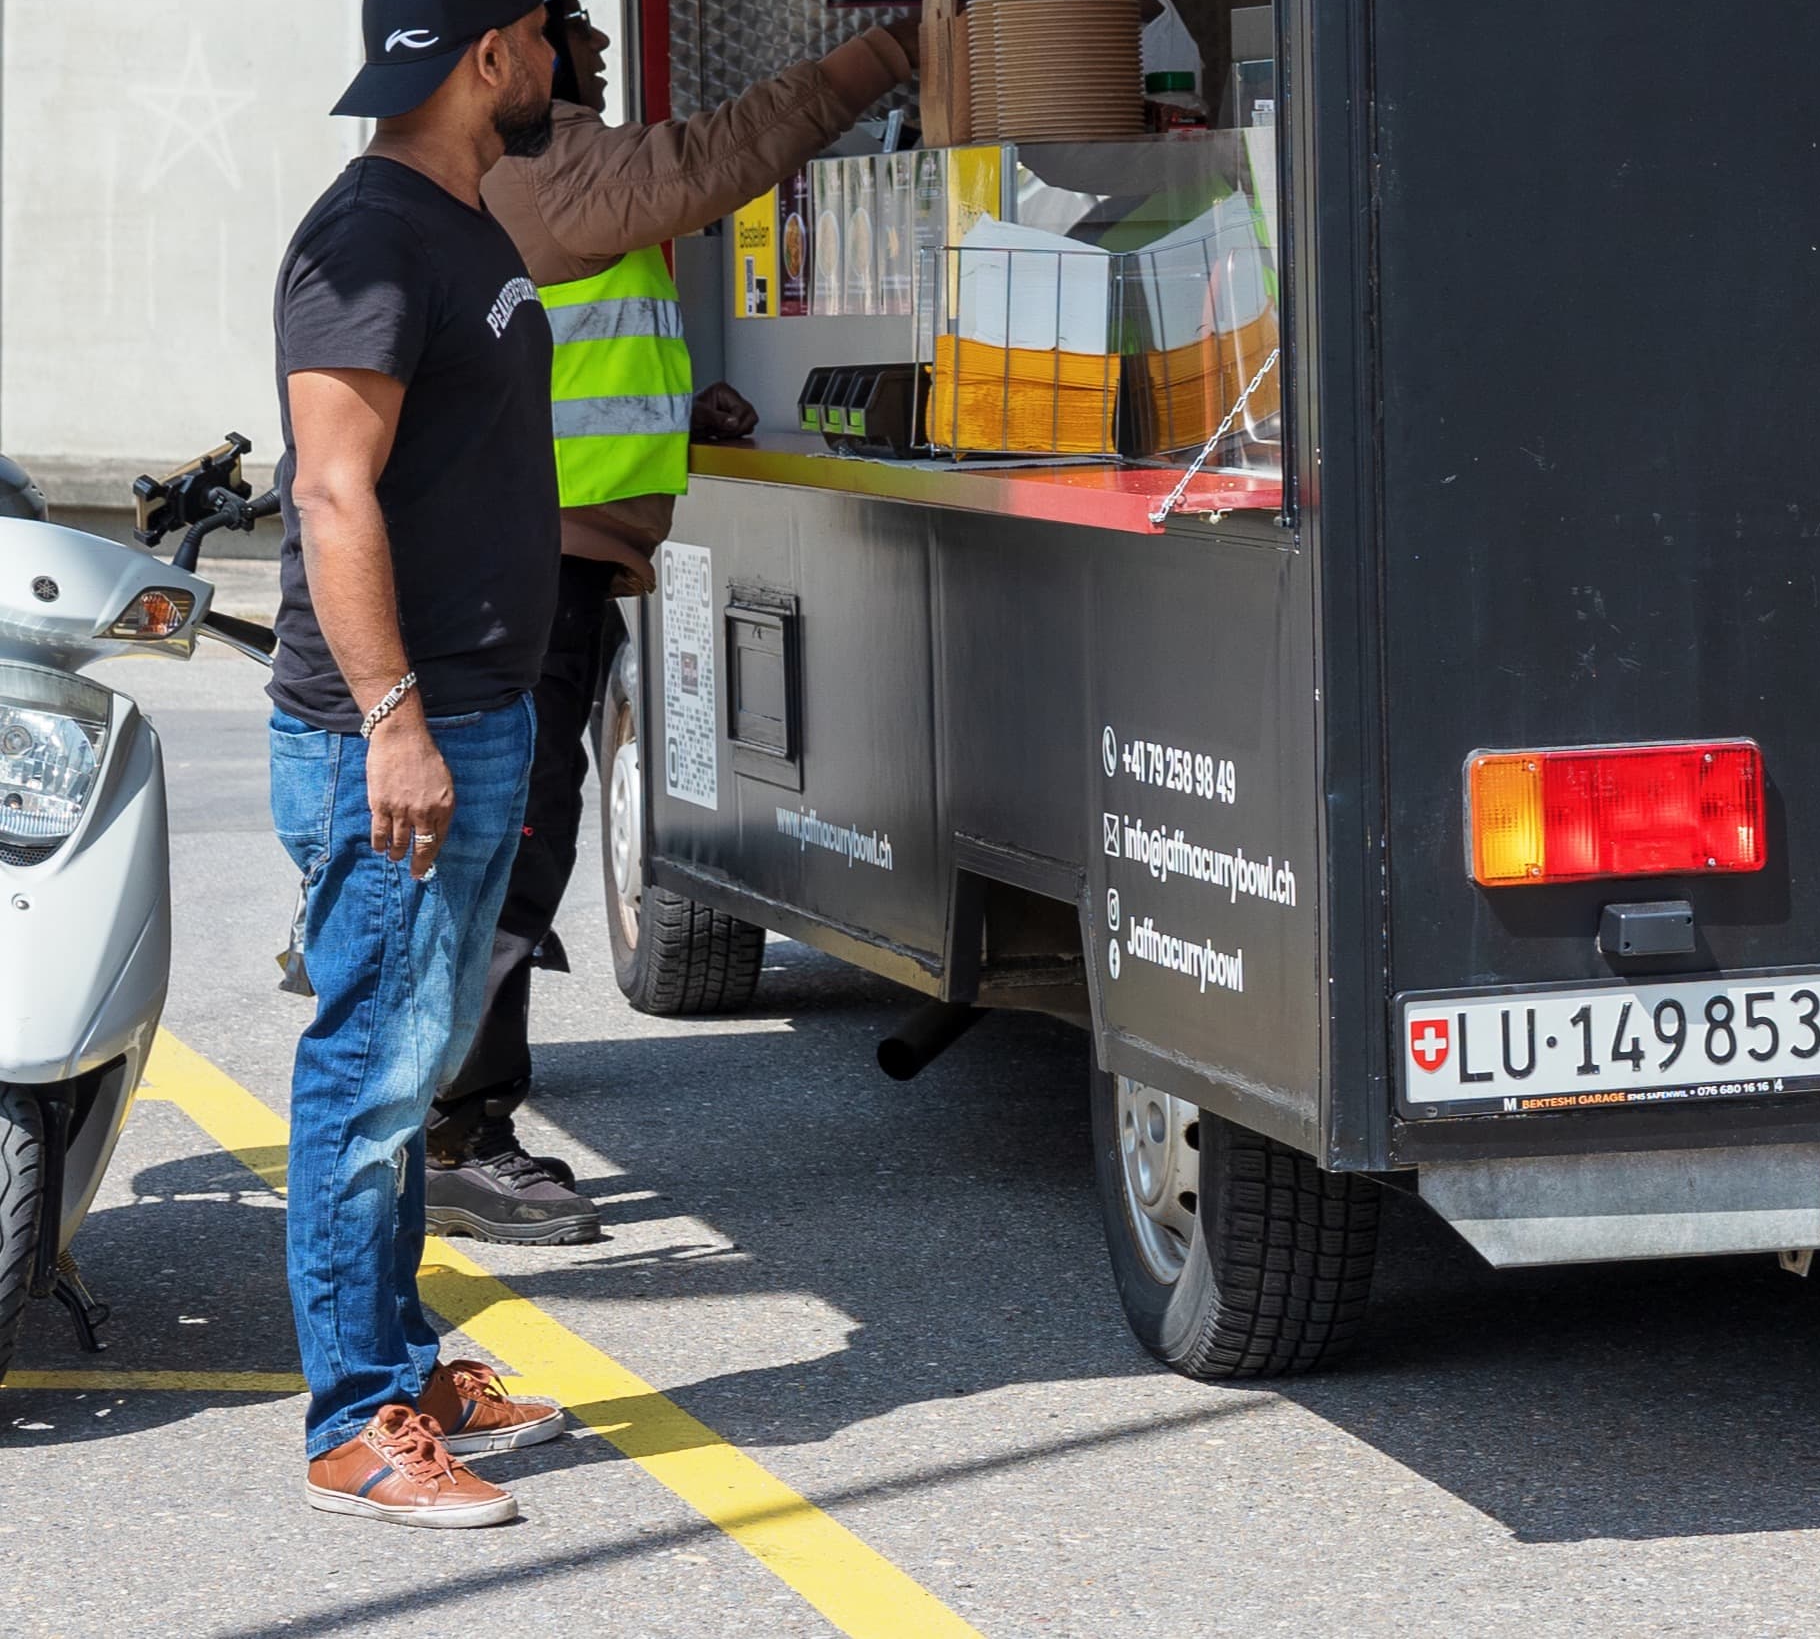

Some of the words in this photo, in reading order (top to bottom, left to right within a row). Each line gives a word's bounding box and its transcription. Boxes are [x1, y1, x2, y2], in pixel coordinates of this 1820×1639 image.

[1122, 740, 1146, 782] +41
[1147, 743, 1164, 787] 79
[1166, 746, 1192, 794] 258
[1195, 753, 1214, 800] 98
[1216, 759, 1236, 804] 49
[775, 805, 893, 871] www.jaffnacurrybowl.ch
[1123, 814, 1297, 907] info@jaffnacurrybowl.ch
[1127, 916, 1243, 994] Jaffnacurrybowl
[1522, 1095, 1576, 1109] BEKTESHI
[1578, 1092, 1626, 1105] GARAGE
[1697, 1085, 1719, 1097] 076
[1720, 1083, 1741, 1094] 680
[1743, 1082, 1756, 1093] 16
[1757, 1080, 1770, 1092] 16
